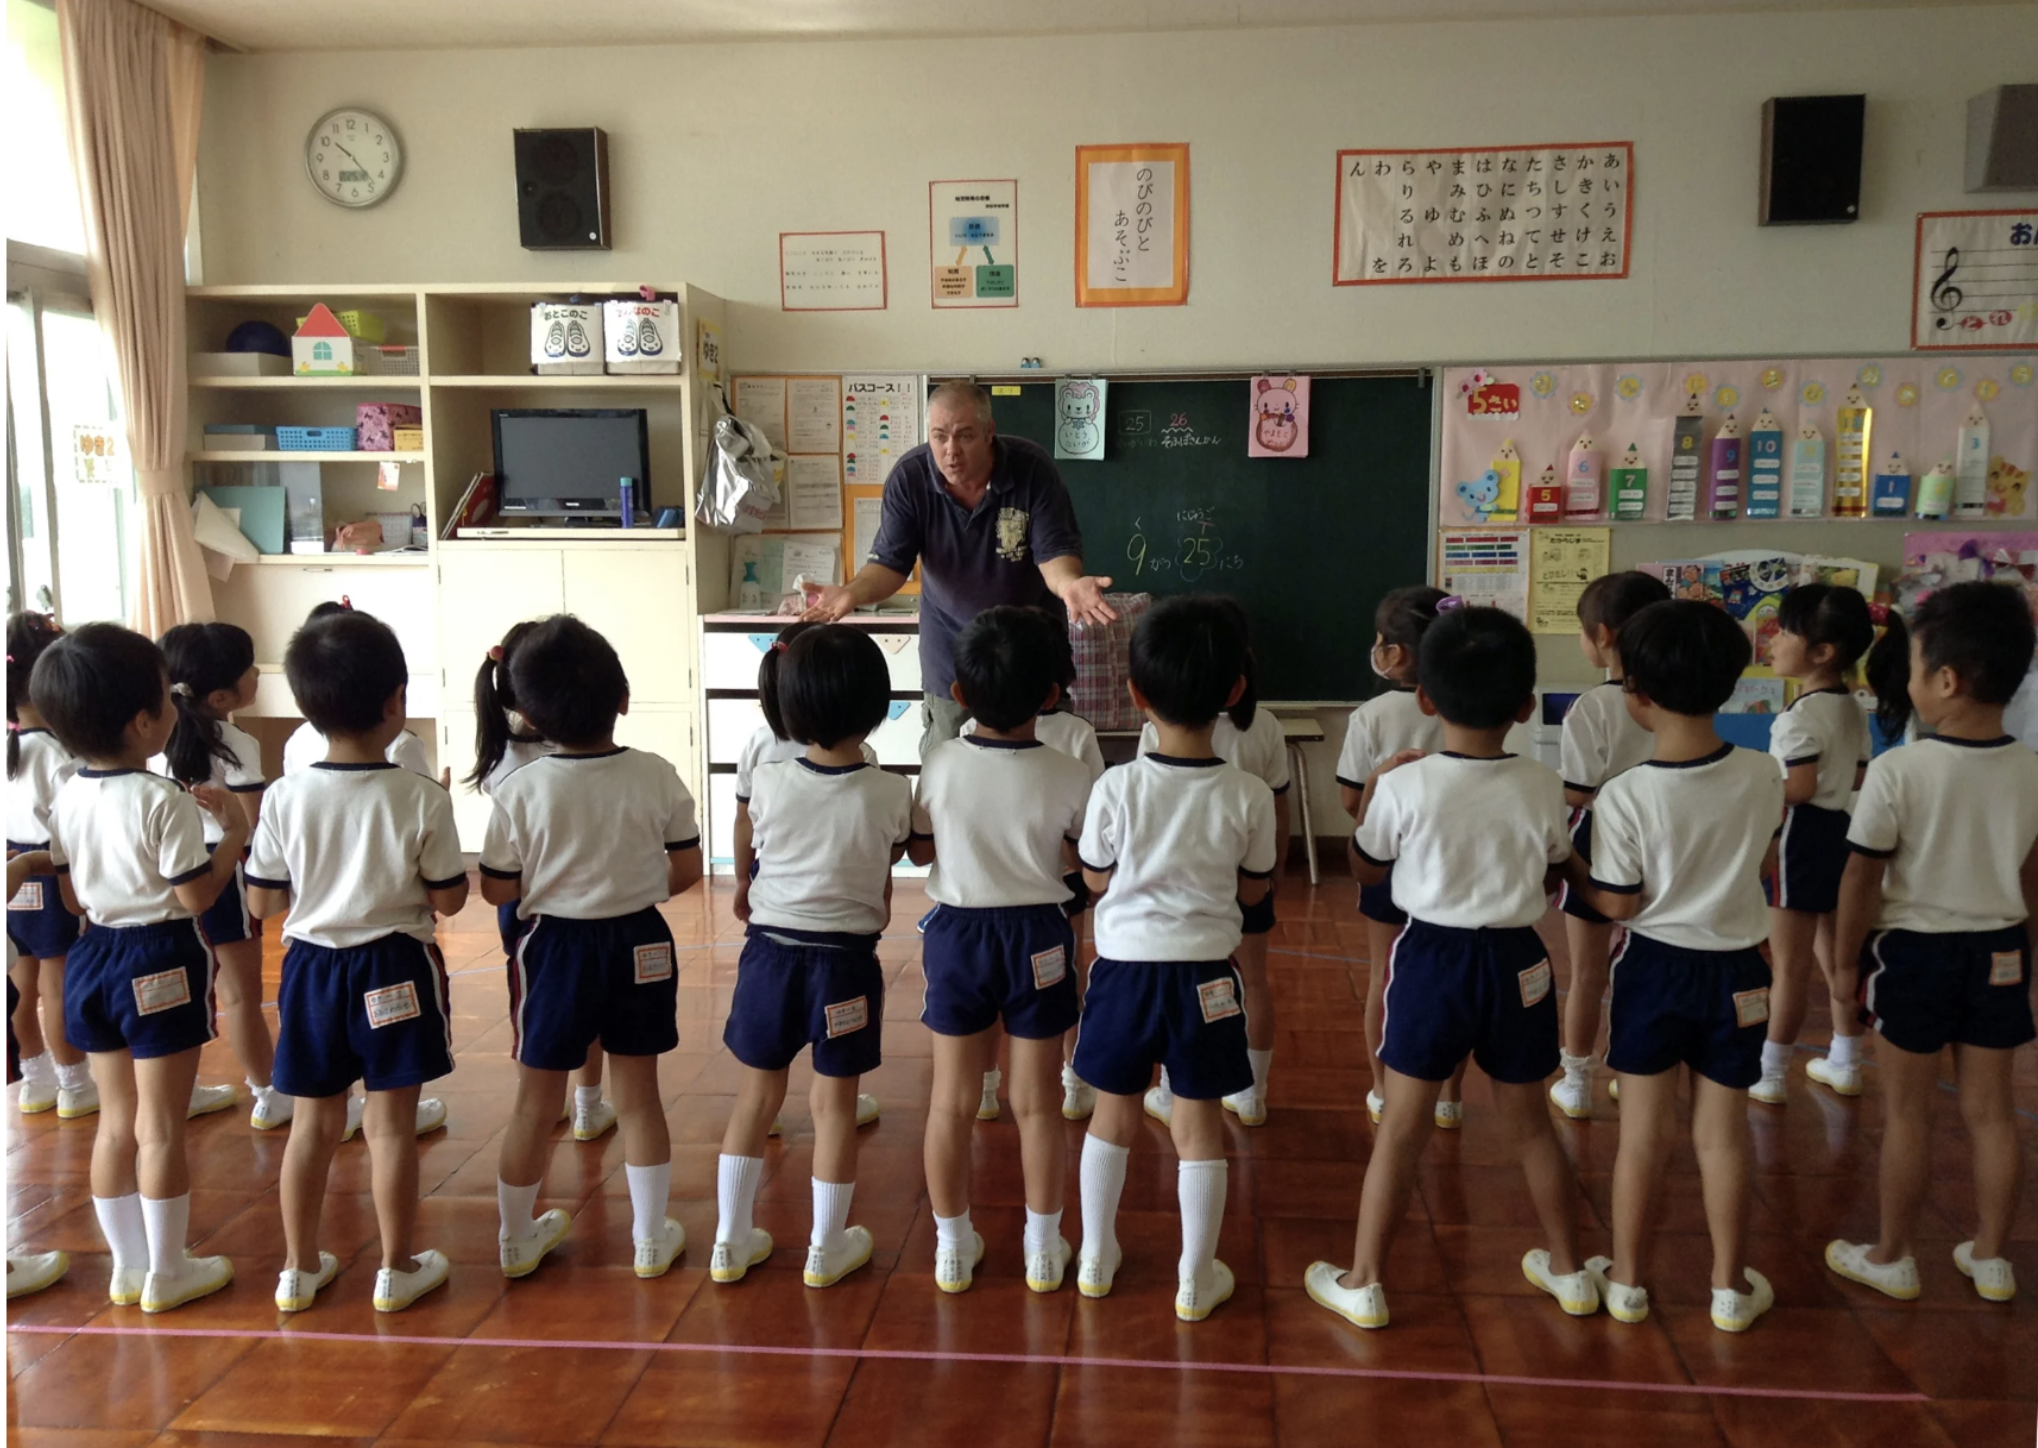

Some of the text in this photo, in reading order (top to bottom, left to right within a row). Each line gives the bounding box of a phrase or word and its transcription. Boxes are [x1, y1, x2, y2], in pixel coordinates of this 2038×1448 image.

[332, 123, 339, 134] 11
[346, 119, 356, 130] 12
[364, 122, 369, 134] 1
[321, 136, 331, 147] 10
[375, 134, 383, 146] 2
[316, 153, 324, 164] 9
[382, 152, 389, 162] 3
[322, 169, 330, 181] 8
[378, 169, 384, 179] 4
[336, 182, 342, 193] 7
[351, 188, 359, 198] 6
[367, 182, 374, 194] 5
[1136, 168, 1153, 251] のびのびと
[2010, 222, 2038, 246] お
[1113, 210, 1130, 281] あそぶこ
[545, 309, 588, 320] おとこのこ
[616, 306, 660, 317] なのこ
[1472, 386, 1517, 414] 5さい
[1125, 416, 1144, 431] 25
[1169, 412, 1188, 427] 26
[1681, 435, 1693, 450] 8
[1757, 439, 1776, 453] 10
[1971, 437, 1982, 450] 3
[1726, 449, 1736, 463] 9
[1578, 460, 1589, 473] 6
[1625, 475, 1635, 488] 7
[1541, 489, 1552, 502] 5
